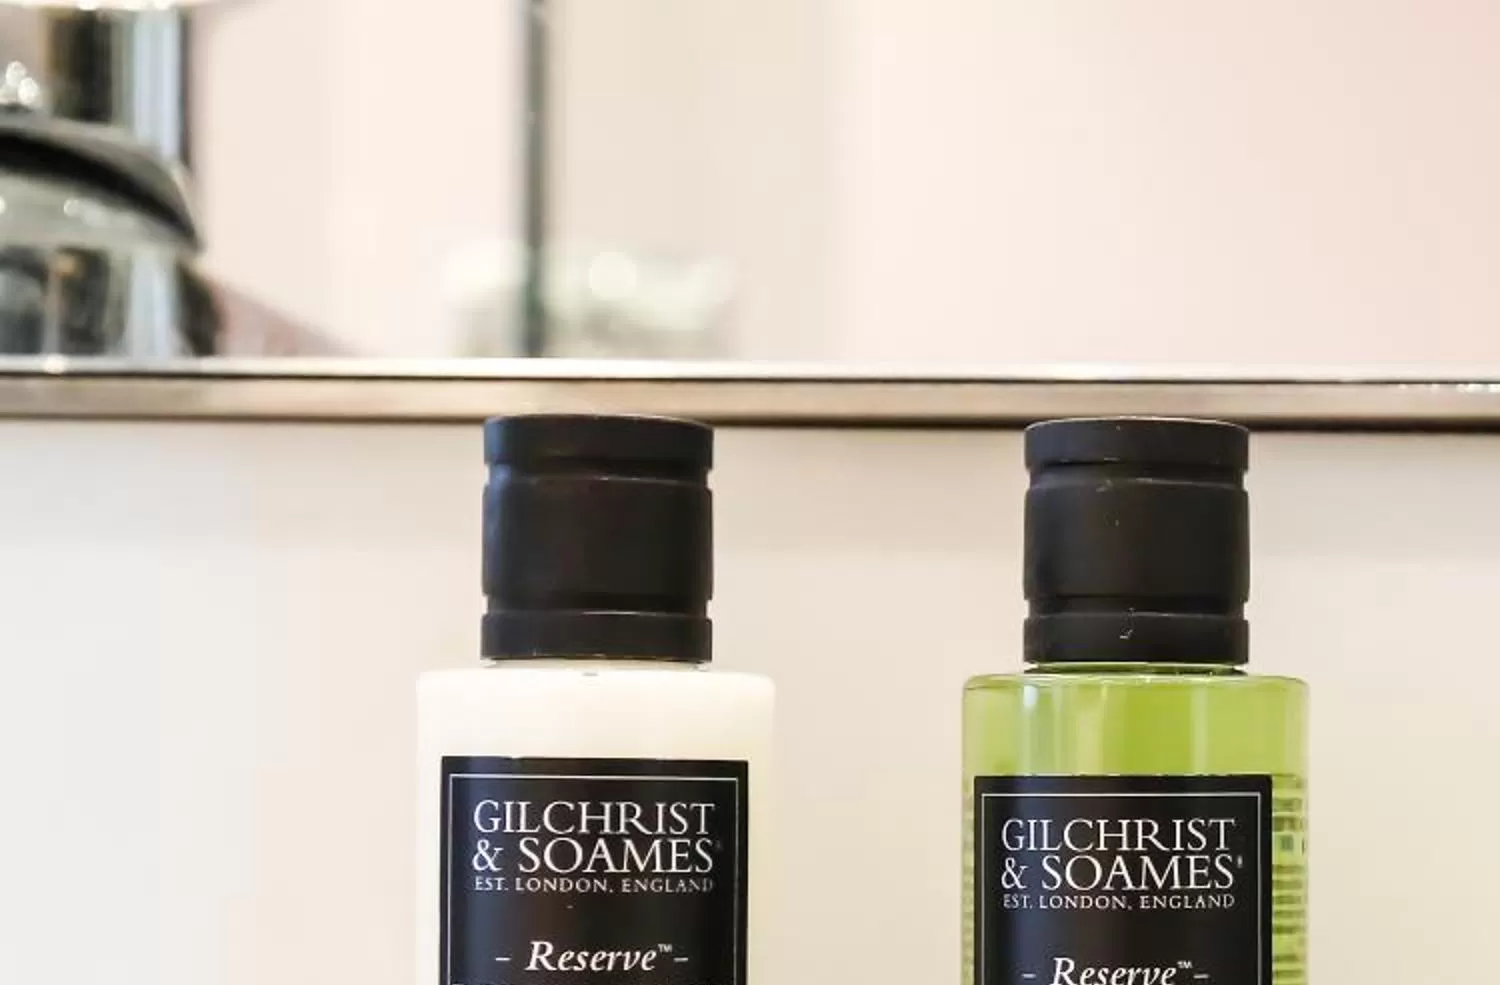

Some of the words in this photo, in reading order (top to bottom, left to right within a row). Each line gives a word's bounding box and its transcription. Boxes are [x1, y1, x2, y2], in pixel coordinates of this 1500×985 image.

[473, 800, 714, 835] GILCHRIST
[1002, 819, 1236, 851] GILCHRIST
[472, 839, 503, 873] &
[518, 837, 713, 873] SOAMES
[622, 878, 713, 893] ENGLAND
[1001, 857, 1027, 888] &
[1140, 894, 1235, 909] ENGLAND
